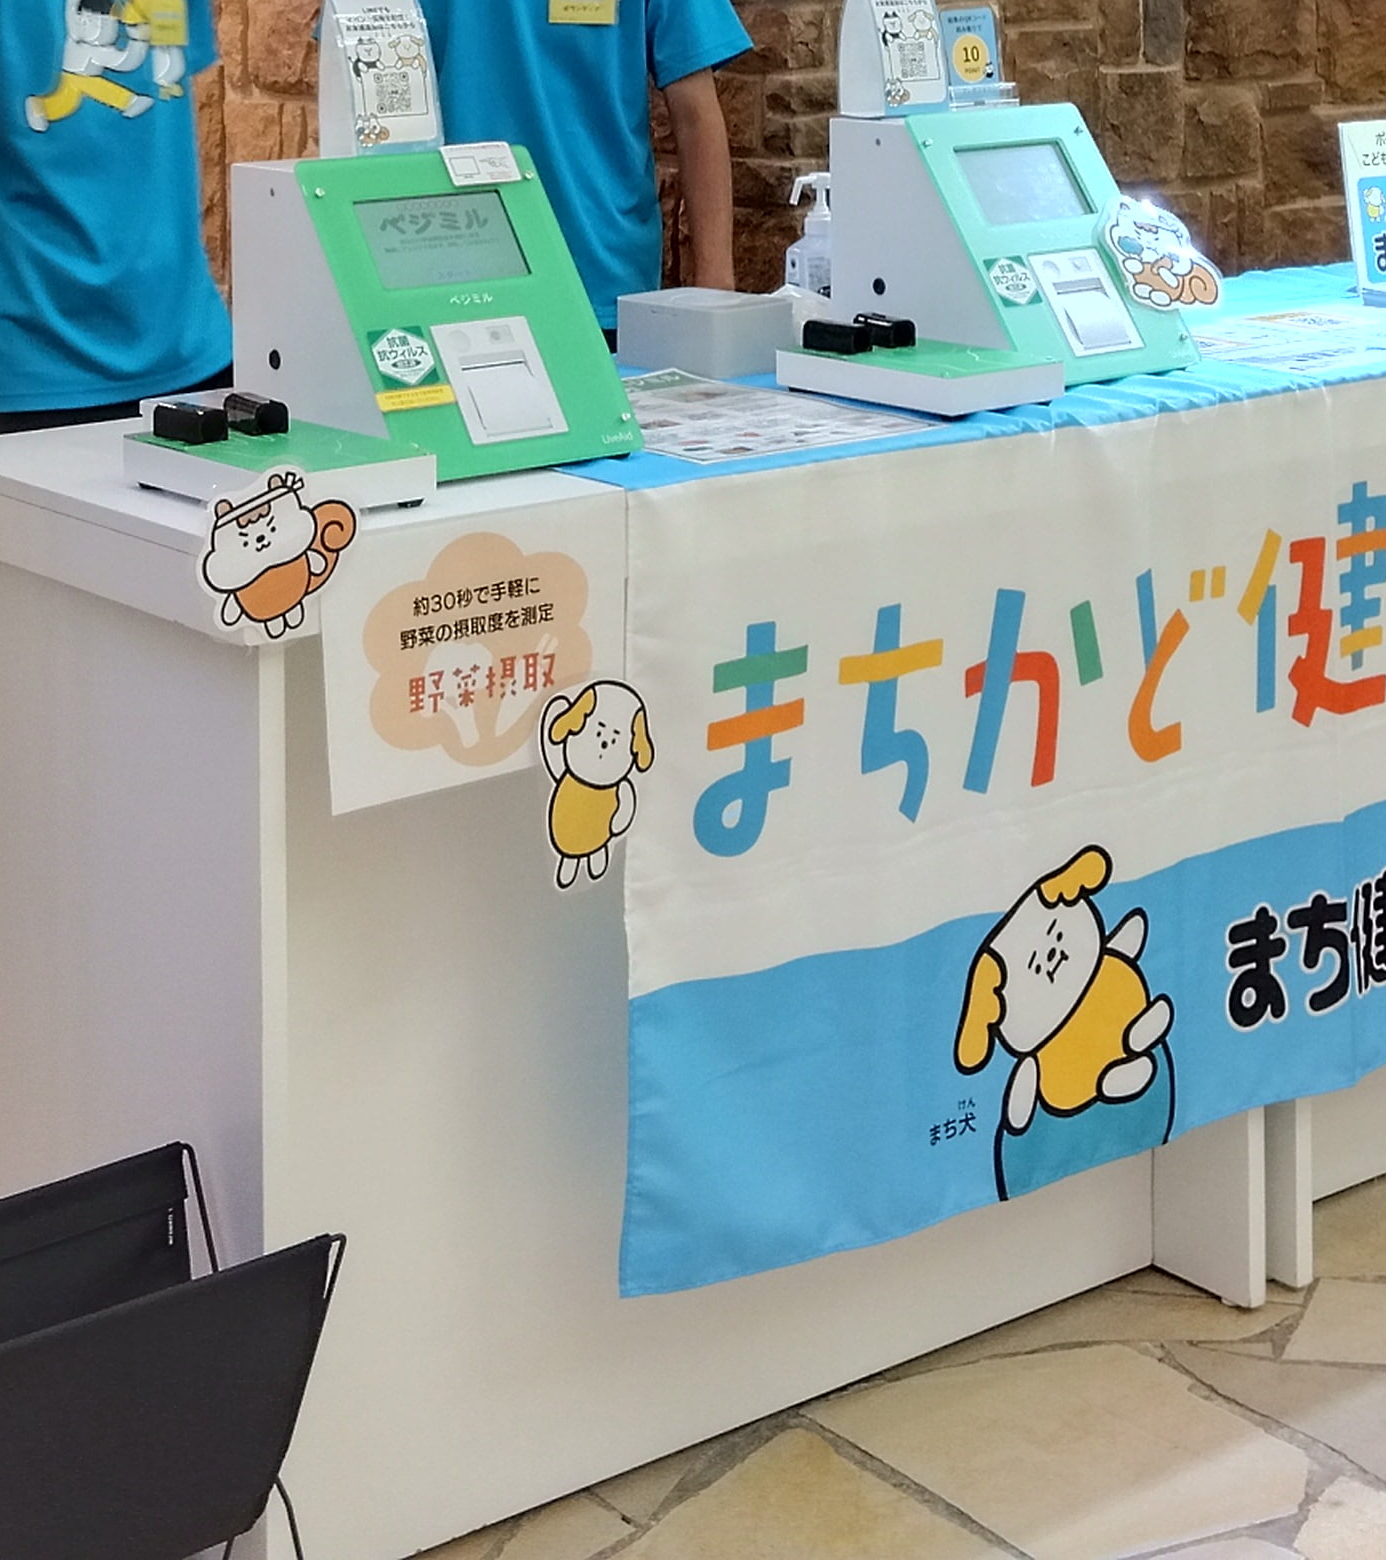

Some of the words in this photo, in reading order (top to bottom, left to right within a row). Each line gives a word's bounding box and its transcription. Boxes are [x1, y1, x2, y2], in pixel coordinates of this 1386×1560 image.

[962, 45, 980, 63] 10
[449, 293, 494, 305] ベジミル
[386, 335, 410, 349] 抗菌
[377, 345, 428, 362] 抗ウィルス
[412, 576, 541, 618] 約30秒で手軽に
[399, 601, 555, 651] 野菜の摂取度を測定
[408, 651, 557, 715] 野菜摂取
[958, 1097, 976, 1110] けん
[929, 1112, 977, 1146] まち犬
